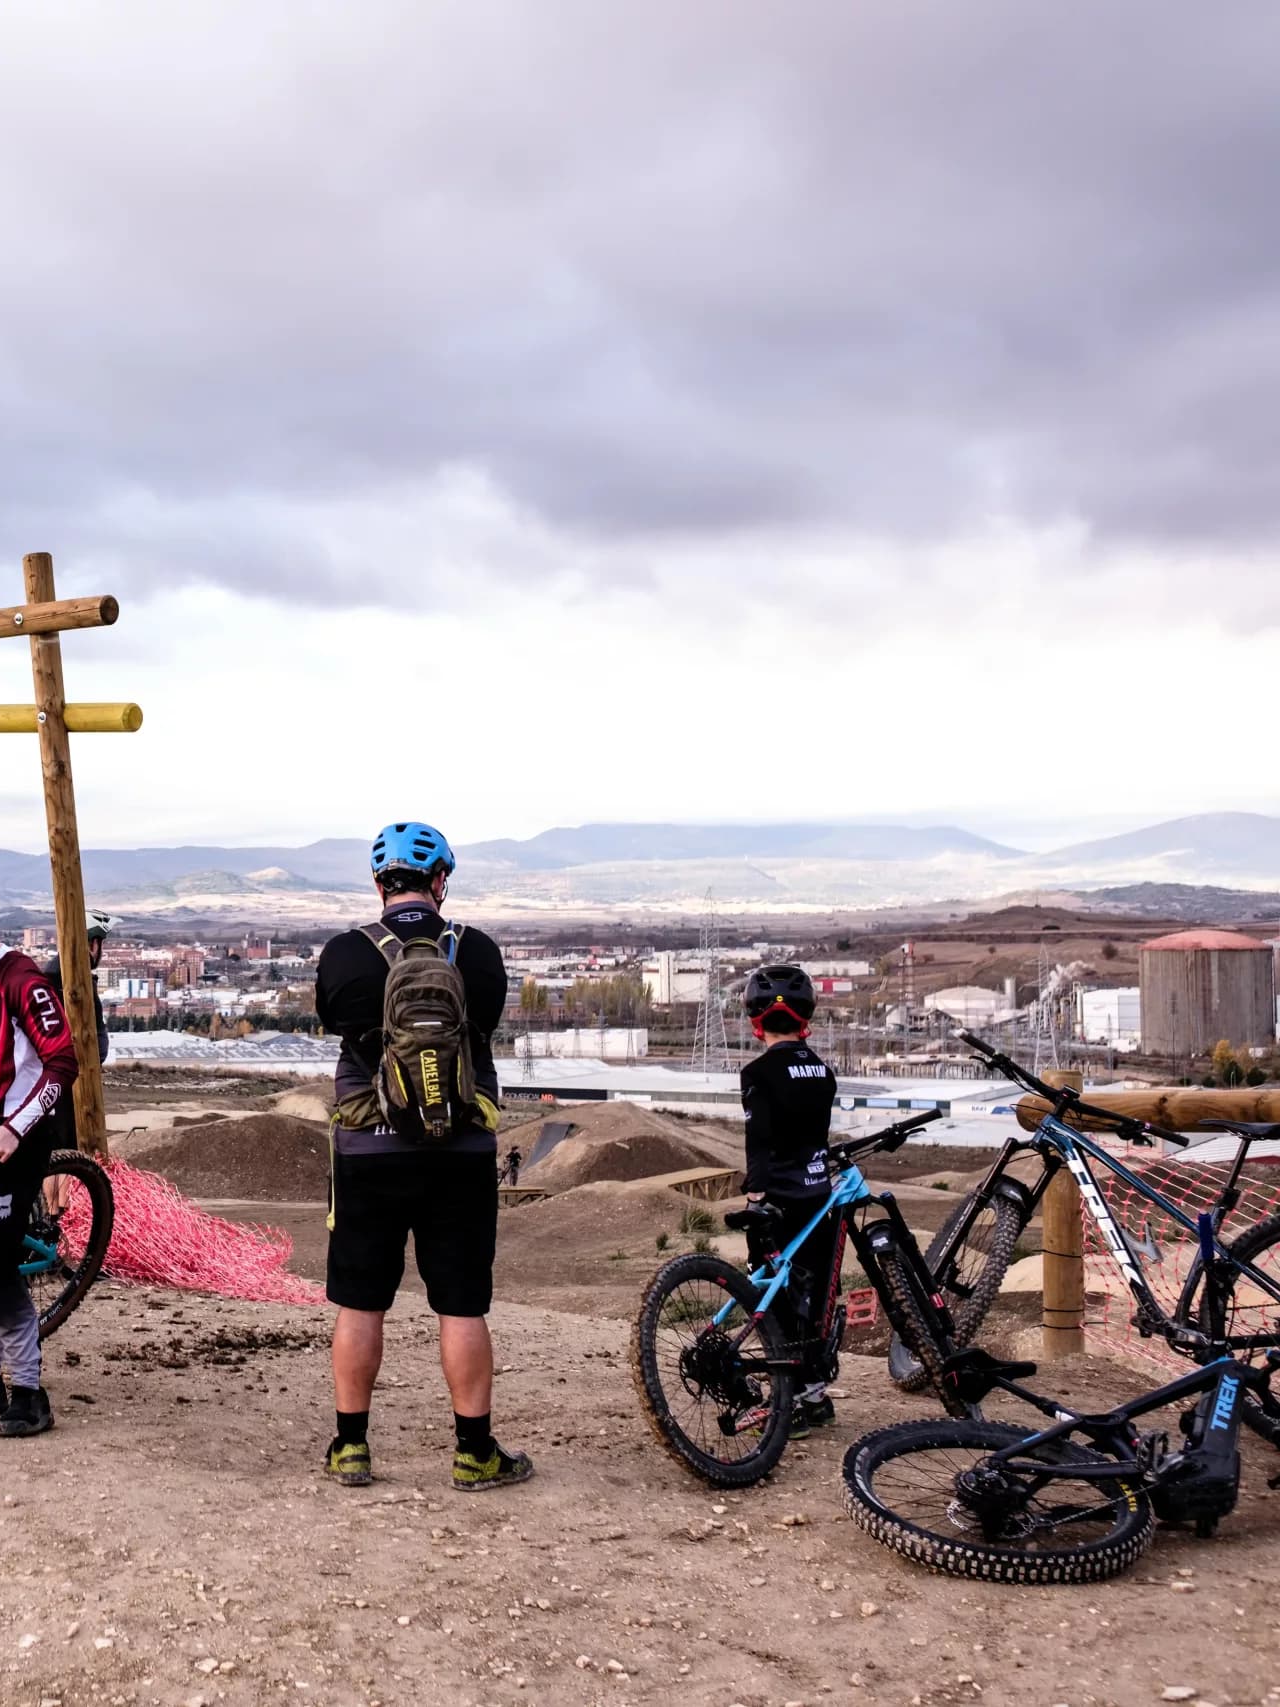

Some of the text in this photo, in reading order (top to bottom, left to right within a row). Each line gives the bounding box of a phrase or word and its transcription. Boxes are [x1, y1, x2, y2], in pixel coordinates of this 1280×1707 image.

[32, 987, 60, 1031] TLD
[419, 1048, 442, 1107] CAMELBAK
[787, 1064, 827, 1079] MARTIN
[1209, 1373, 1241, 1431] TREK
